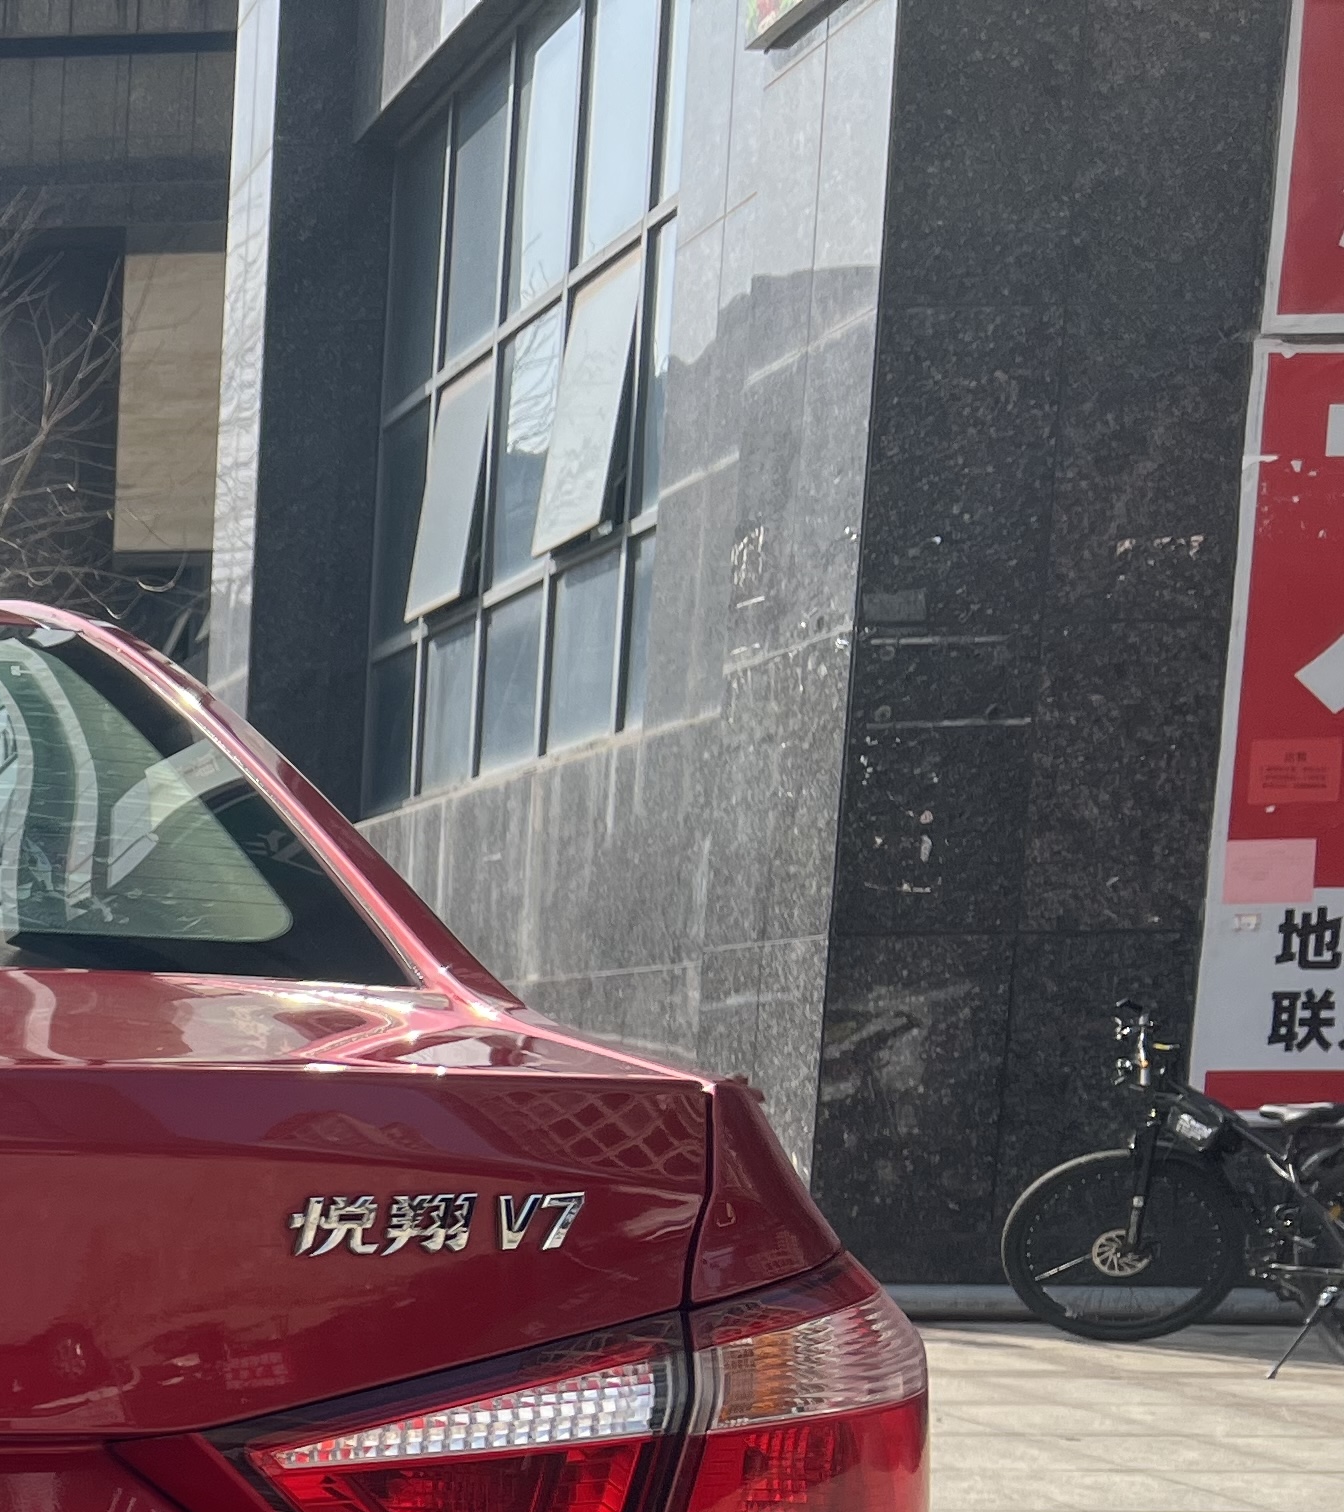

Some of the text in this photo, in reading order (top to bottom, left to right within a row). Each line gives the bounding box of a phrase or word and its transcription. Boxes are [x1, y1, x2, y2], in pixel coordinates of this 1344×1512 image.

[1274, 905, 1343, 970] 地
[1267, 988, 1344, 1053] 联
[288, 1190, 587, 1258] 悦翔 V7
